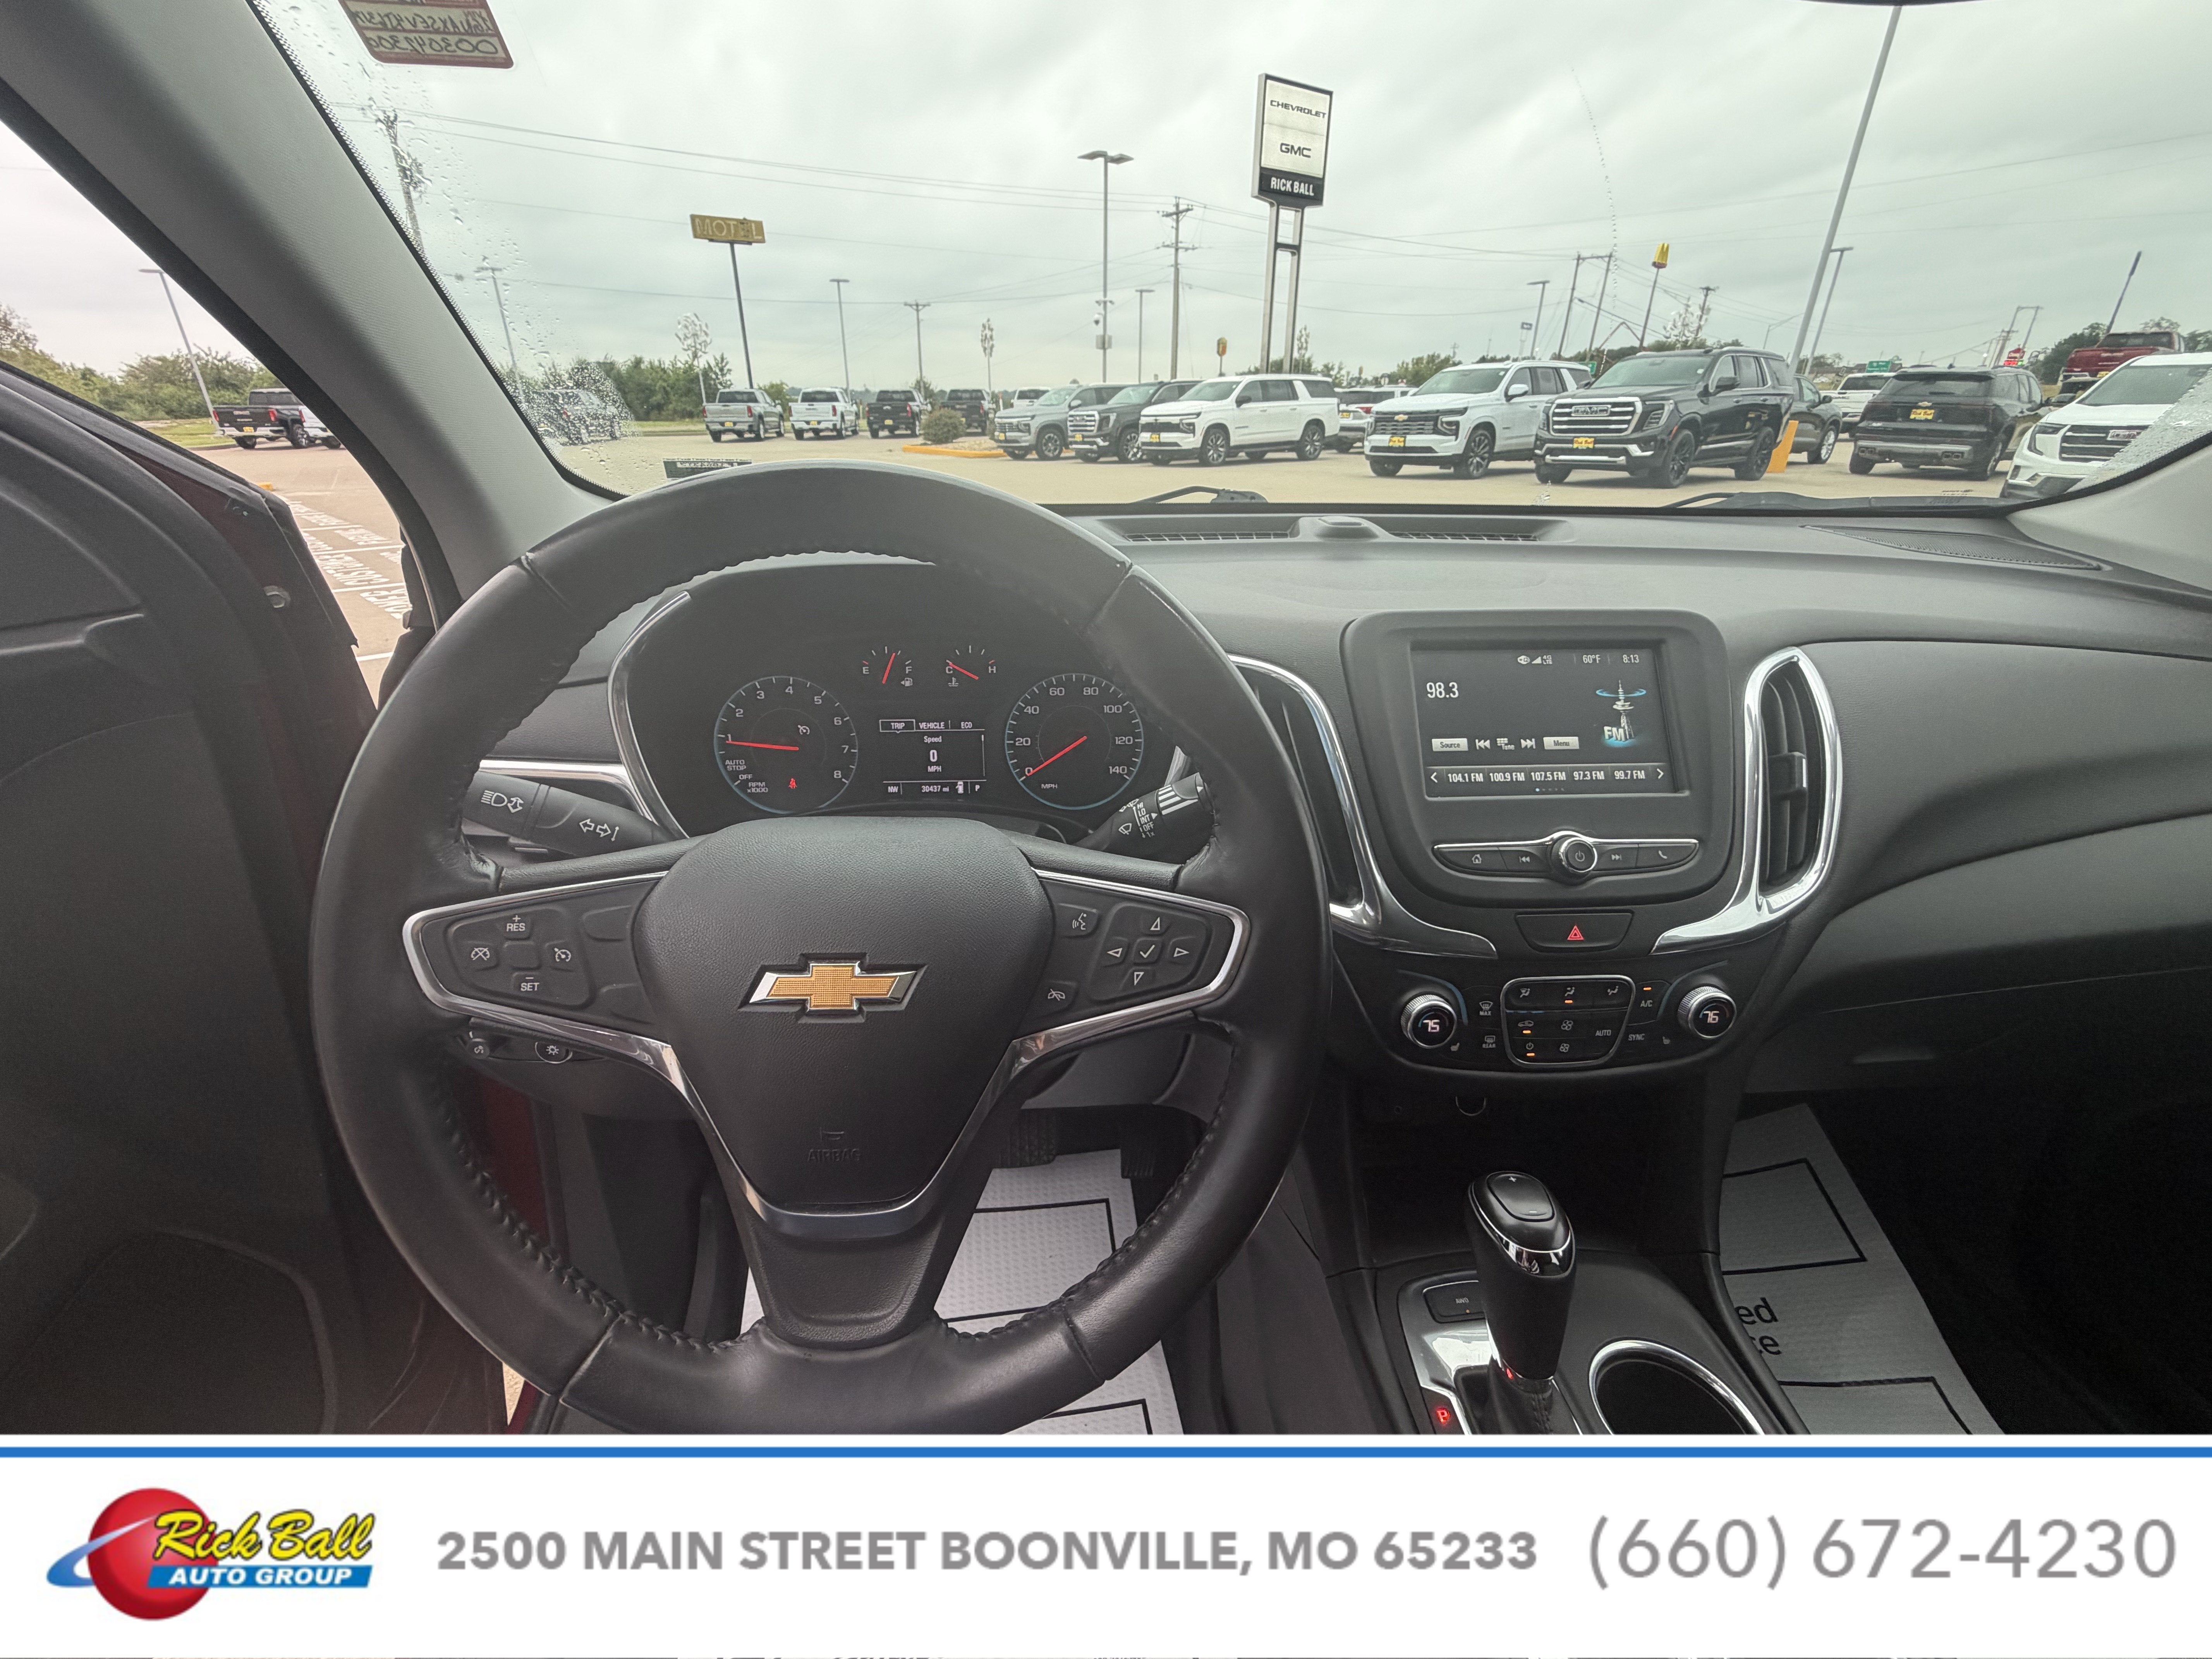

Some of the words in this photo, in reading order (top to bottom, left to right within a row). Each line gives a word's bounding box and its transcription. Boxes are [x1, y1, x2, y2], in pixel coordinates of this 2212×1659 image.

[1270, 100, 1326, 118] CHEVROLET
[1280, 142, 1311, 158] GMC
[1271, 177, 1292, 192] RICK
[1293, 181, 1314, 196] BALL
[1583, 654, 1601, 663] 60°F
[1622, 654, 1640, 663] 8:13
[785, 686, 793, 694] 4
[1049, 687, 1065, 696] 60
[1083, 687, 1099, 695] 80
[1426, 682, 1459, 698] 98.3
[756, 691, 764, 699] 3
[814, 696, 822, 704] 5
[735, 709, 744, 718] 2
[1024, 706, 1039, 714] 40
[1103, 705, 1122, 713] 100
[834, 717, 842, 725] 6
[1015, 737, 1031, 746] 20
[1115, 736, 1133, 745] 120
[841, 745, 849, 753] 7
[930, 750, 938, 762] 0
[833, 770, 842, 778] 8
[1025, 767, 1033, 776] 0
[1109, 766, 1127, 774] 140
[1448, 773, 1469, 782] 104.1
[1471, 773, 1484, 782] FM
[1489, 773, 1510, 781] 100.9
[1513, 772, 1525, 781] FM
[1530, 772, 1552, 781] 107.5
[1554, 771, 1566, 781] FM
[1573, 771, 1591, 780] 97.3
[1592, 771, 1605, 780] FM
[1614, 771, 1632, 780] 99.7
[1633, 770, 1645, 779] FM
[1138, 808, 1146, 817] LO
[1140, 814, 1151, 824] INT
[1142, 821, 1154, 831] OFF
[506, 923, 526, 932] RES
[520, 982, 539, 991] SET
[1703, 1011, 1719, 1023] 76
[1423, 1019, 1440, 1032] 75
[807, 1148, 860, 1162] AIRBAG
[1437, 1408, 1449, 1423] P
